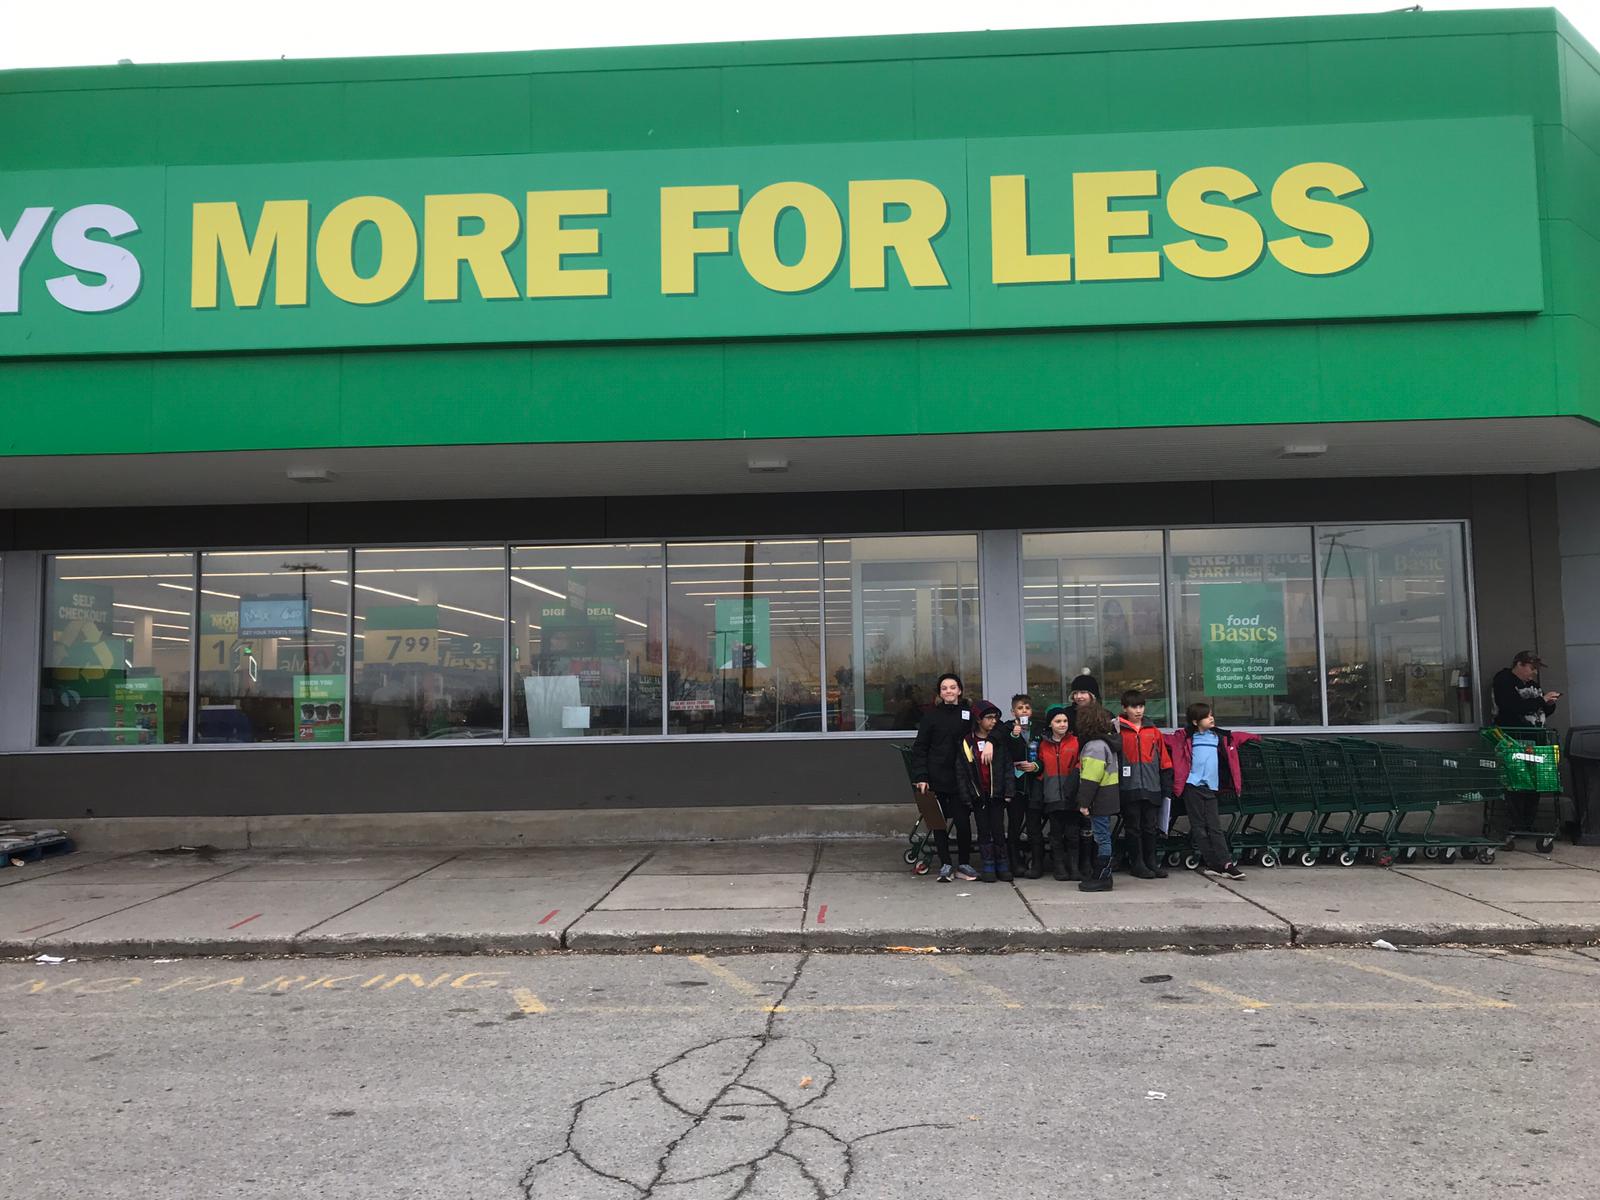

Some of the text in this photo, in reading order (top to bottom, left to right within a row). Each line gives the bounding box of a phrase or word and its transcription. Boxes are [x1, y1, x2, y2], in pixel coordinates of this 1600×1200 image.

[190, 189, 609, 309] MORE
[660, 178, 951, 295] FOR
[989, 161, 1371, 285] LESS
[1187, 566, 1232, 577] START
[59, 606, 107, 623] CHECKOUT
[587, 607, 614, 616] DEAL
[1226, 614, 1260, 626] food
[1209, 623, 1278, 642] Basics
[336, 644, 346, 657] 3
[472, 642, 481, 654] 2
[1220, 657, 1245, 665] Monday
[1249, 657, 1269, 665] Friday
[1252, 673, 1275, 681] Sunday
[157, 971, 511, 993] PARKING
